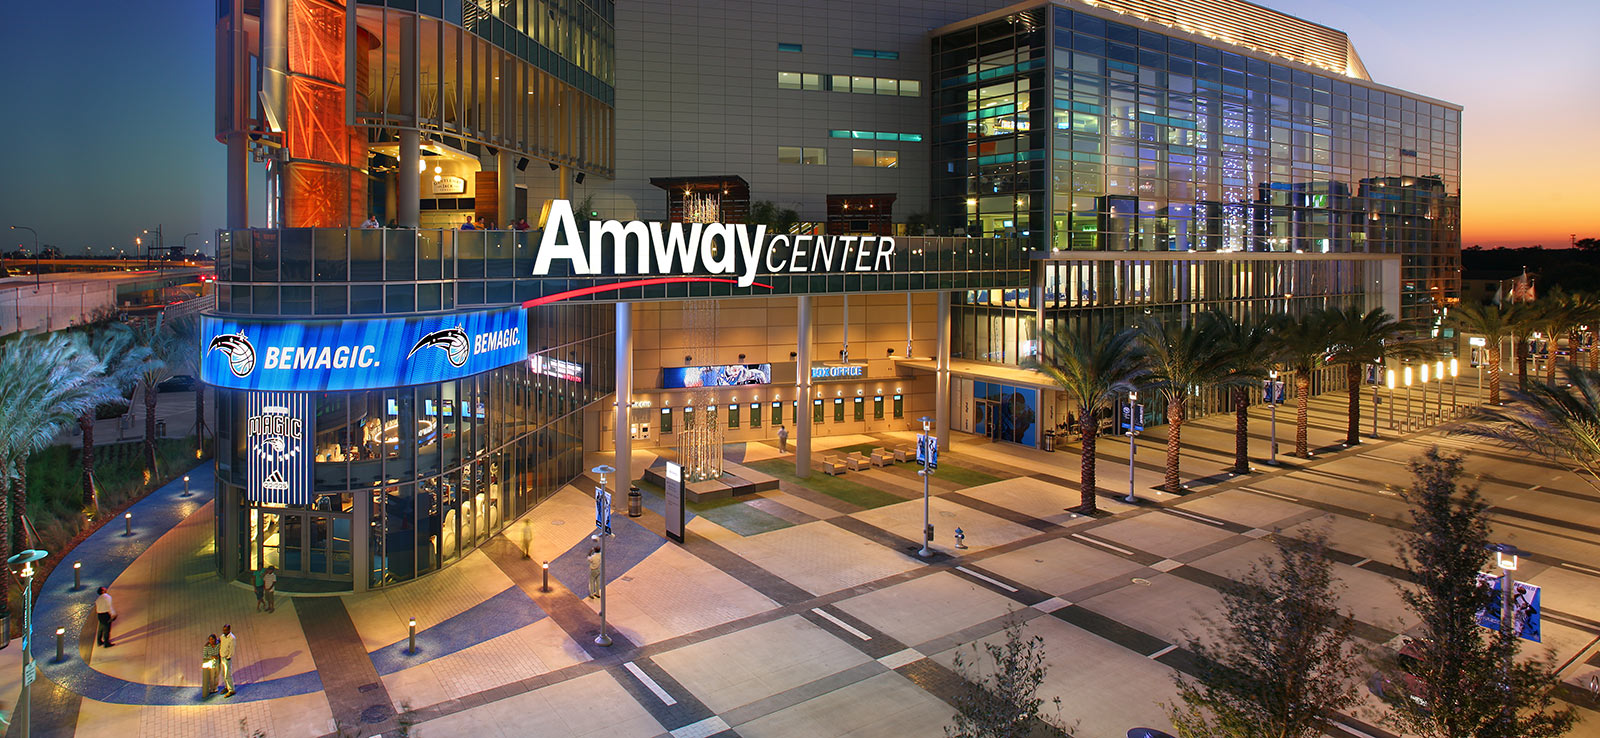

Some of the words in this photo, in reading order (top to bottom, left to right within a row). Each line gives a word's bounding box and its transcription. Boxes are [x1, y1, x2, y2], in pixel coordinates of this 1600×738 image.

[532, 199, 767, 288] Amway
[765, 234, 895, 272] CENTER
[474, 327, 521, 355] BEMAGIC.
[263, 345, 380, 370] BEMAGIC.
[811, 367, 830, 378] BOX
[830, 366, 863, 377] OFFICE
[247, 415, 302, 439] MAGIC
